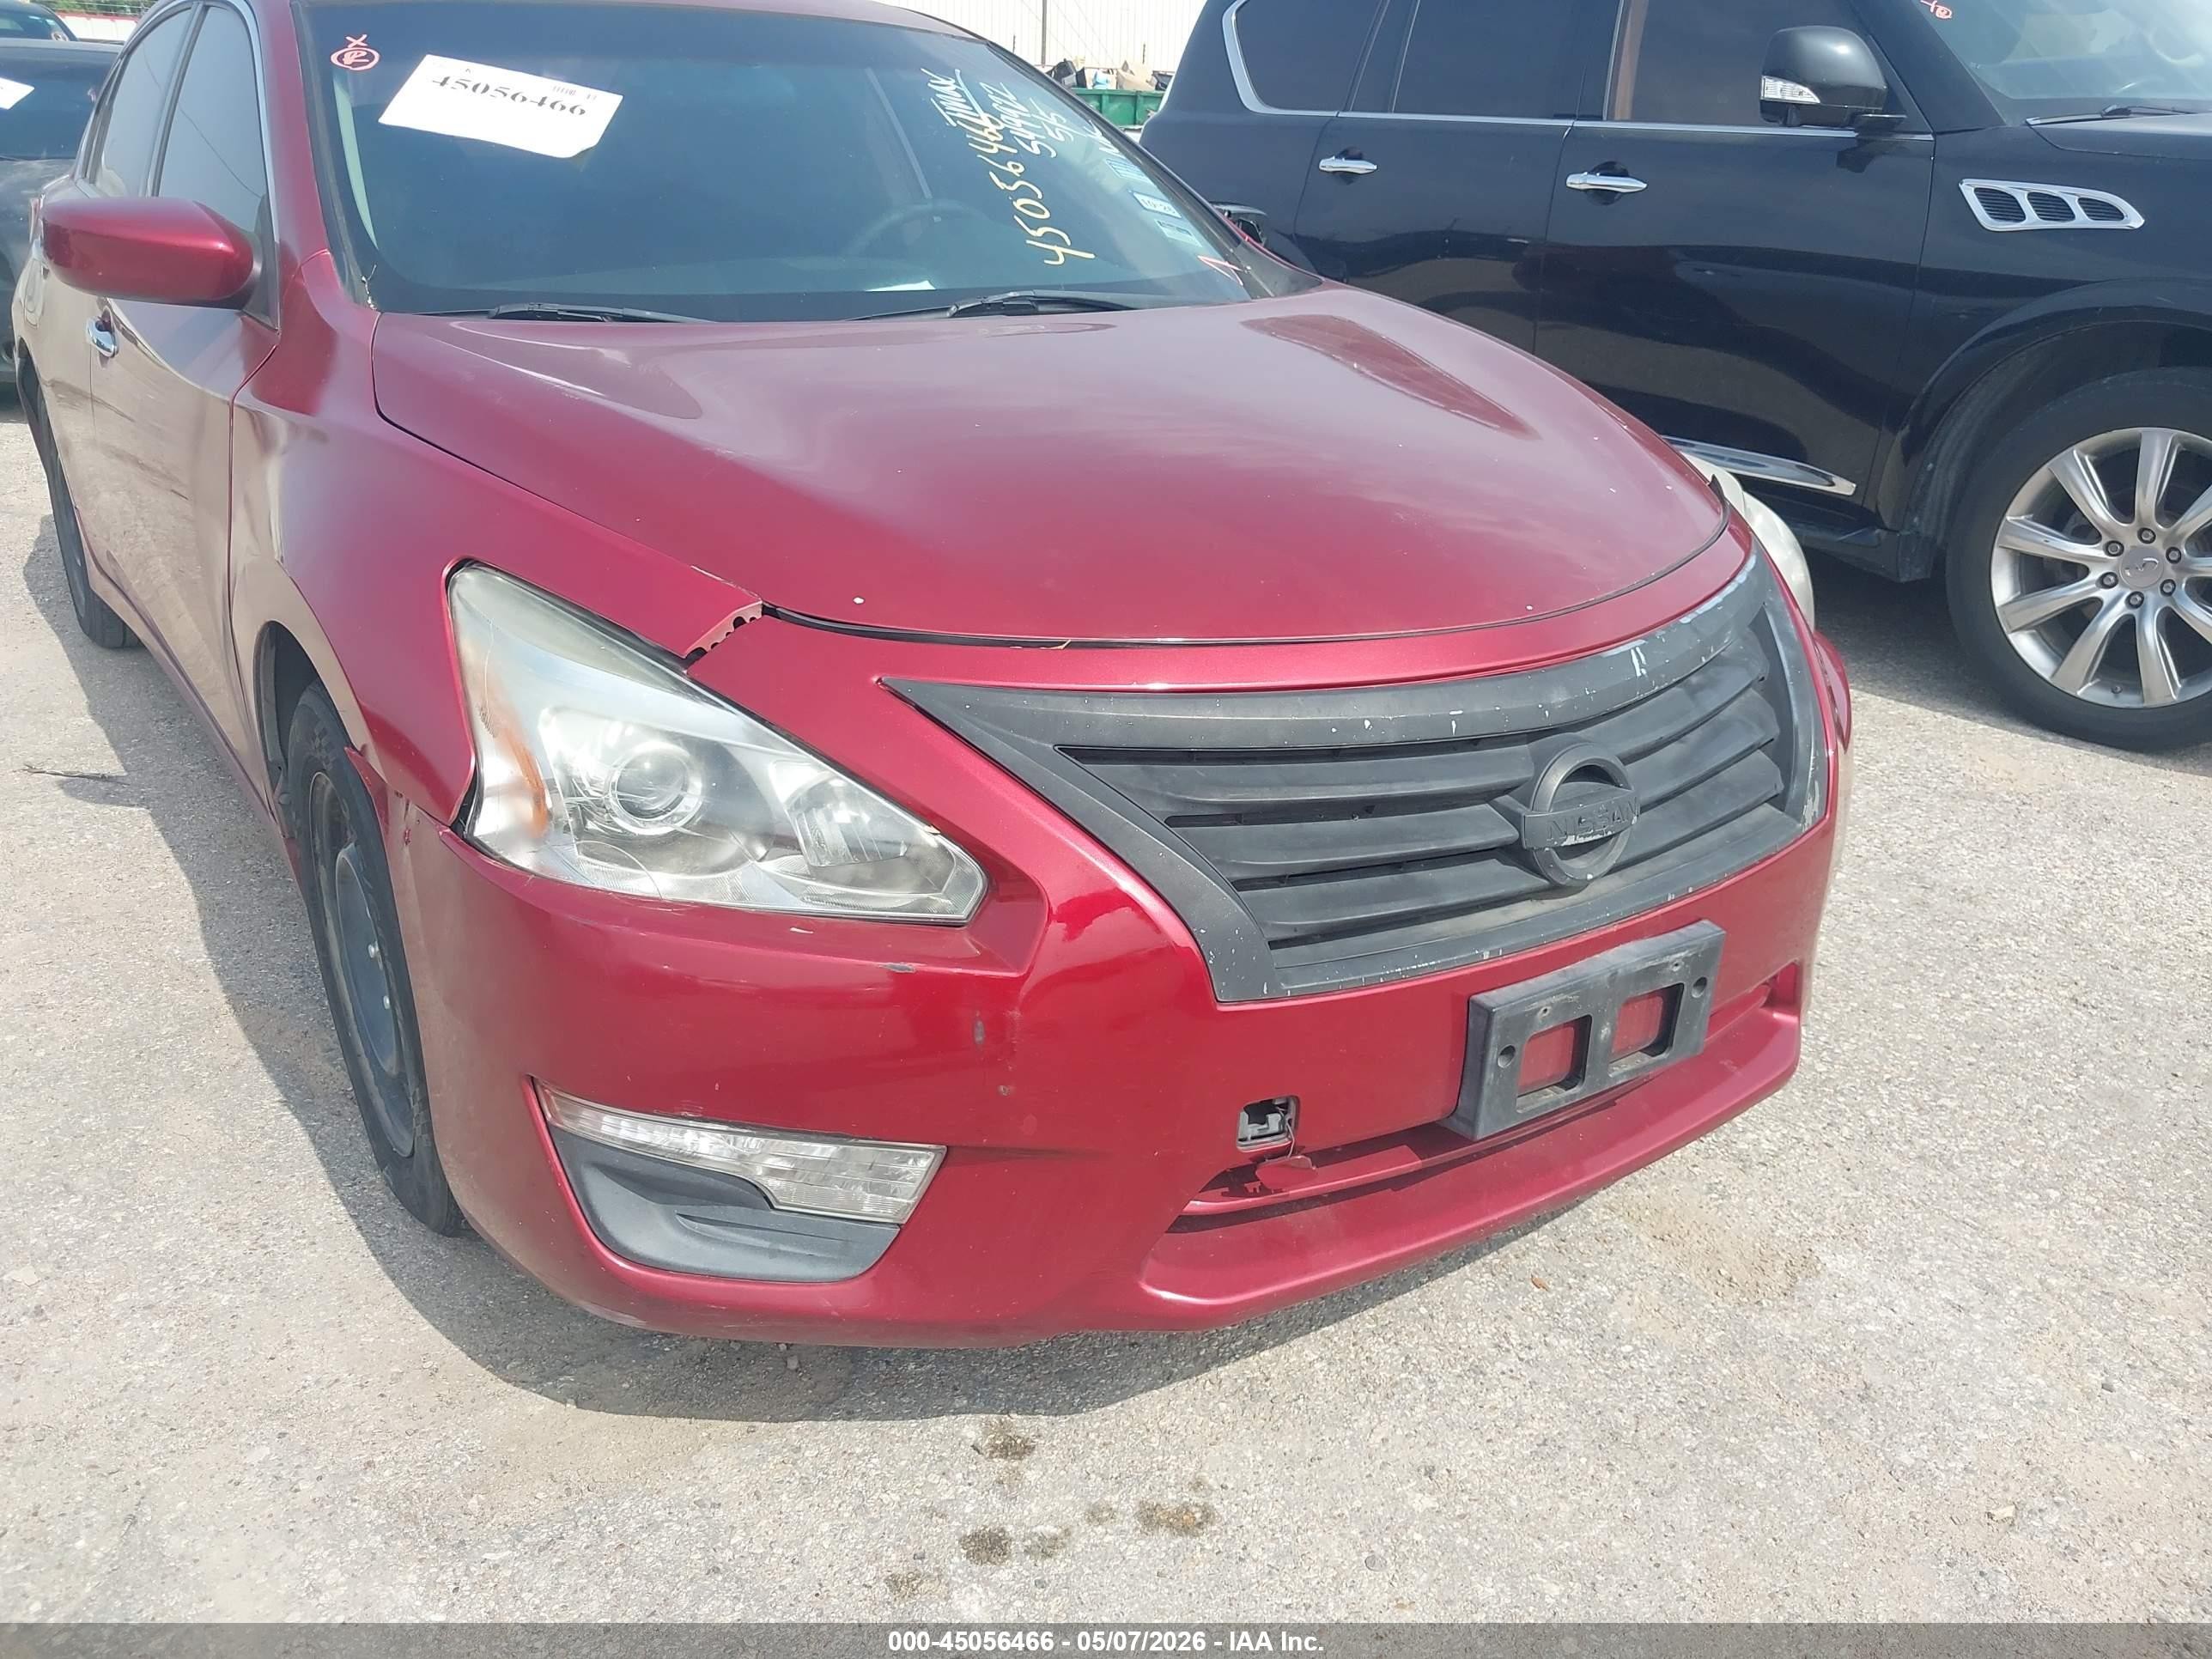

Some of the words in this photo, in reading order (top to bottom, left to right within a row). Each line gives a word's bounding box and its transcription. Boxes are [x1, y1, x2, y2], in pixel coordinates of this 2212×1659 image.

[432, 76, 586, 116] 45056466
[945, 111, 1096, 266] 45056466
[1547, 797, 1641, 841] NISSAN
